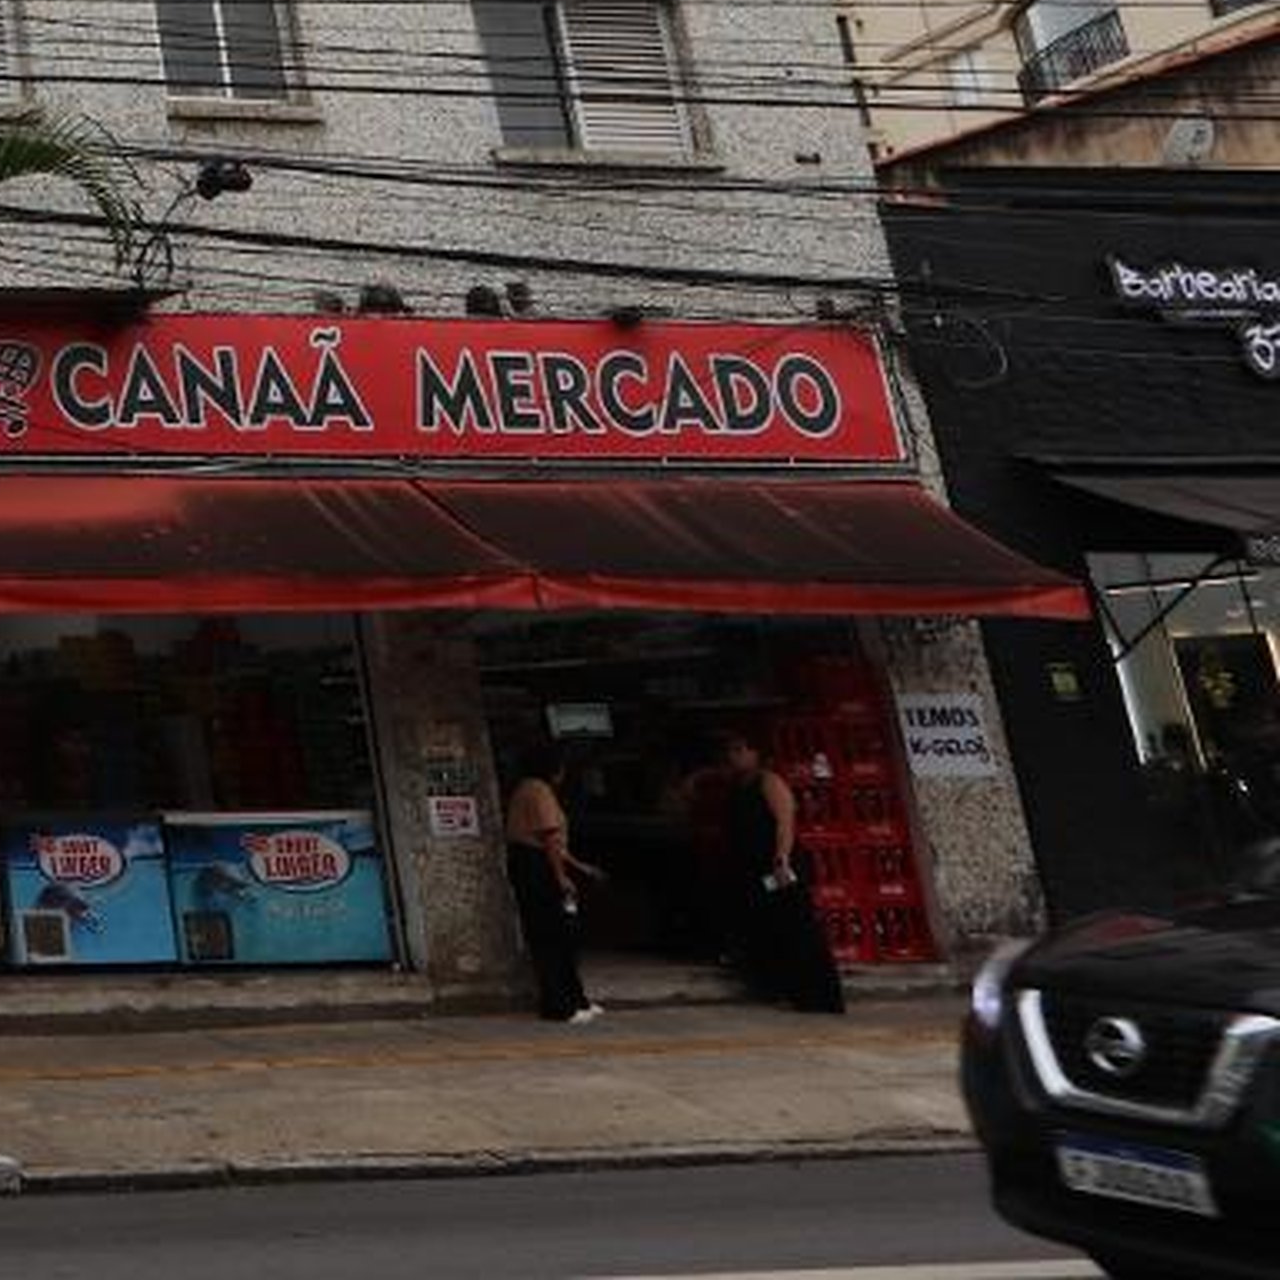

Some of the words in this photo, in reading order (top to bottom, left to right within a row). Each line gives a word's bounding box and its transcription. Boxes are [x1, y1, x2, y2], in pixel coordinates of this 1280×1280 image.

[49, 326, 373, 433] CANAÃ
[414, 347, 844, 437] MERCADO
[905, 705, 979, 728] TEMOS
